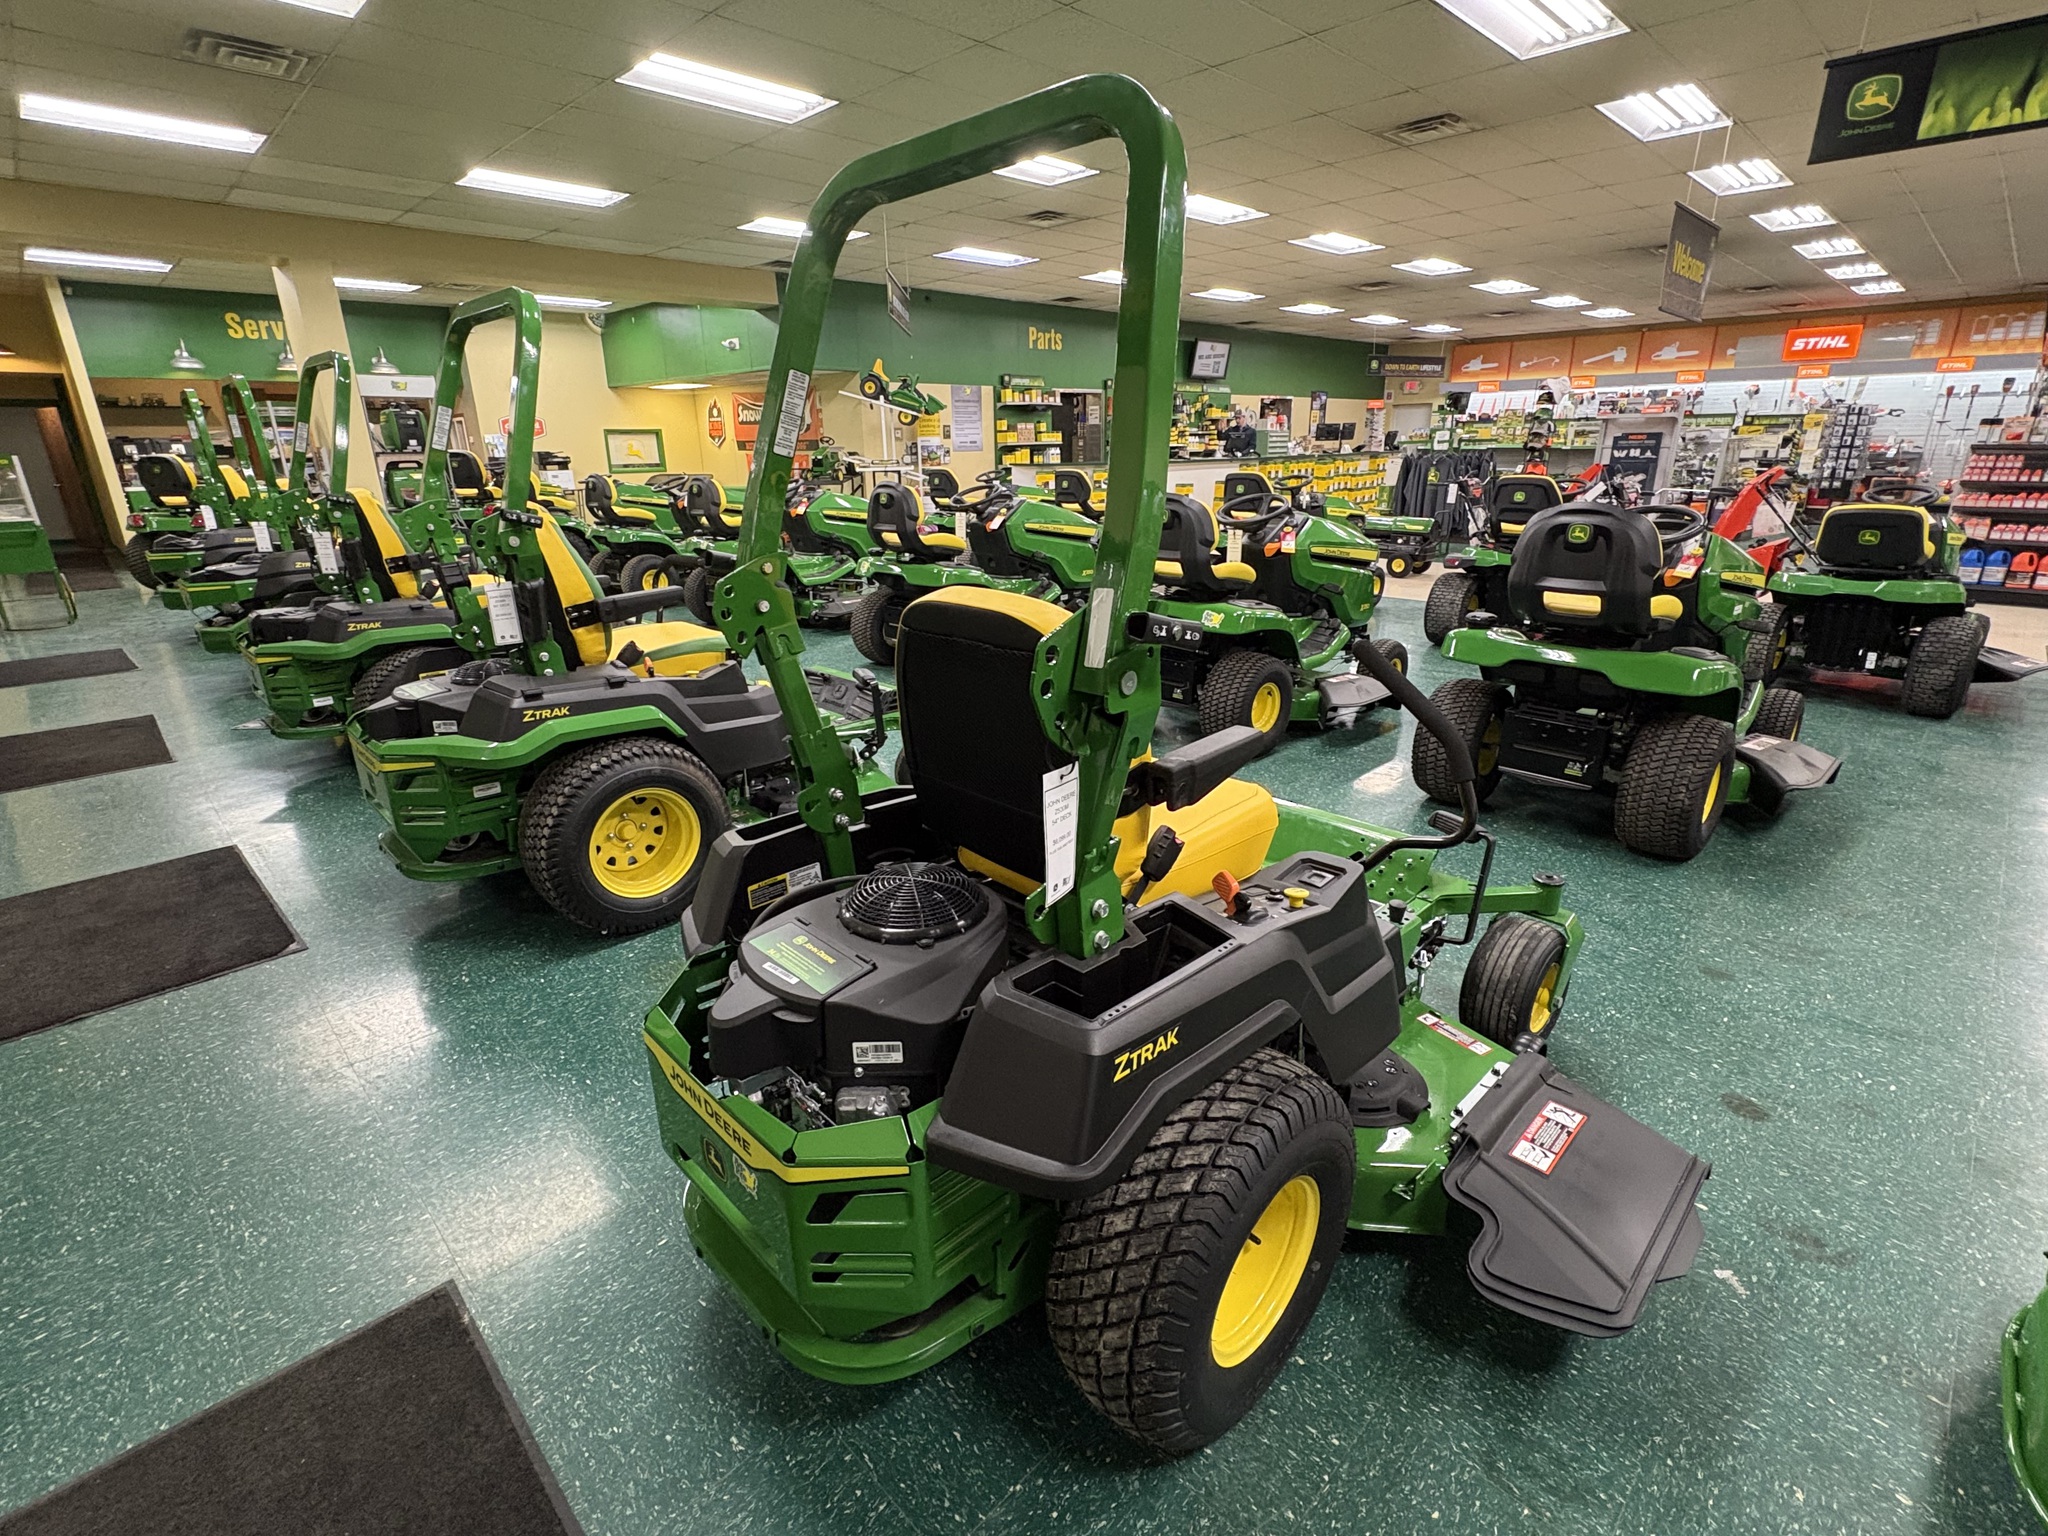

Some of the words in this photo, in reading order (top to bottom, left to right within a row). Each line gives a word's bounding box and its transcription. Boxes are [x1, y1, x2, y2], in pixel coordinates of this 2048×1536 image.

[1838, 128, 1864, 138] JOHN
[1865, 122, 1896, 133] DEERE
[1672, 240, 1706, 284] Welcome
[225, 312, 284, 341] Serv
[1029, 326, 1063, 351] Parts
[1791, 335, 1851, 351] STIHL
[1420, 364, 1442, 372] LIFESTYLE
[738, 405, 763, 422] Snow
[347, 622, 382, 632] ZTRAK
[523, 706, 570, 722] ZTRAK
[1047, 799, 1061, 809] JOHN
[1061, 790, 1076, 803] DEERE
[1113, 1026, 1179, 1083] ZTRAK
[670, 1066, 702, 1108] JOHN
[704, 1098, 752, 1158] DEERE
